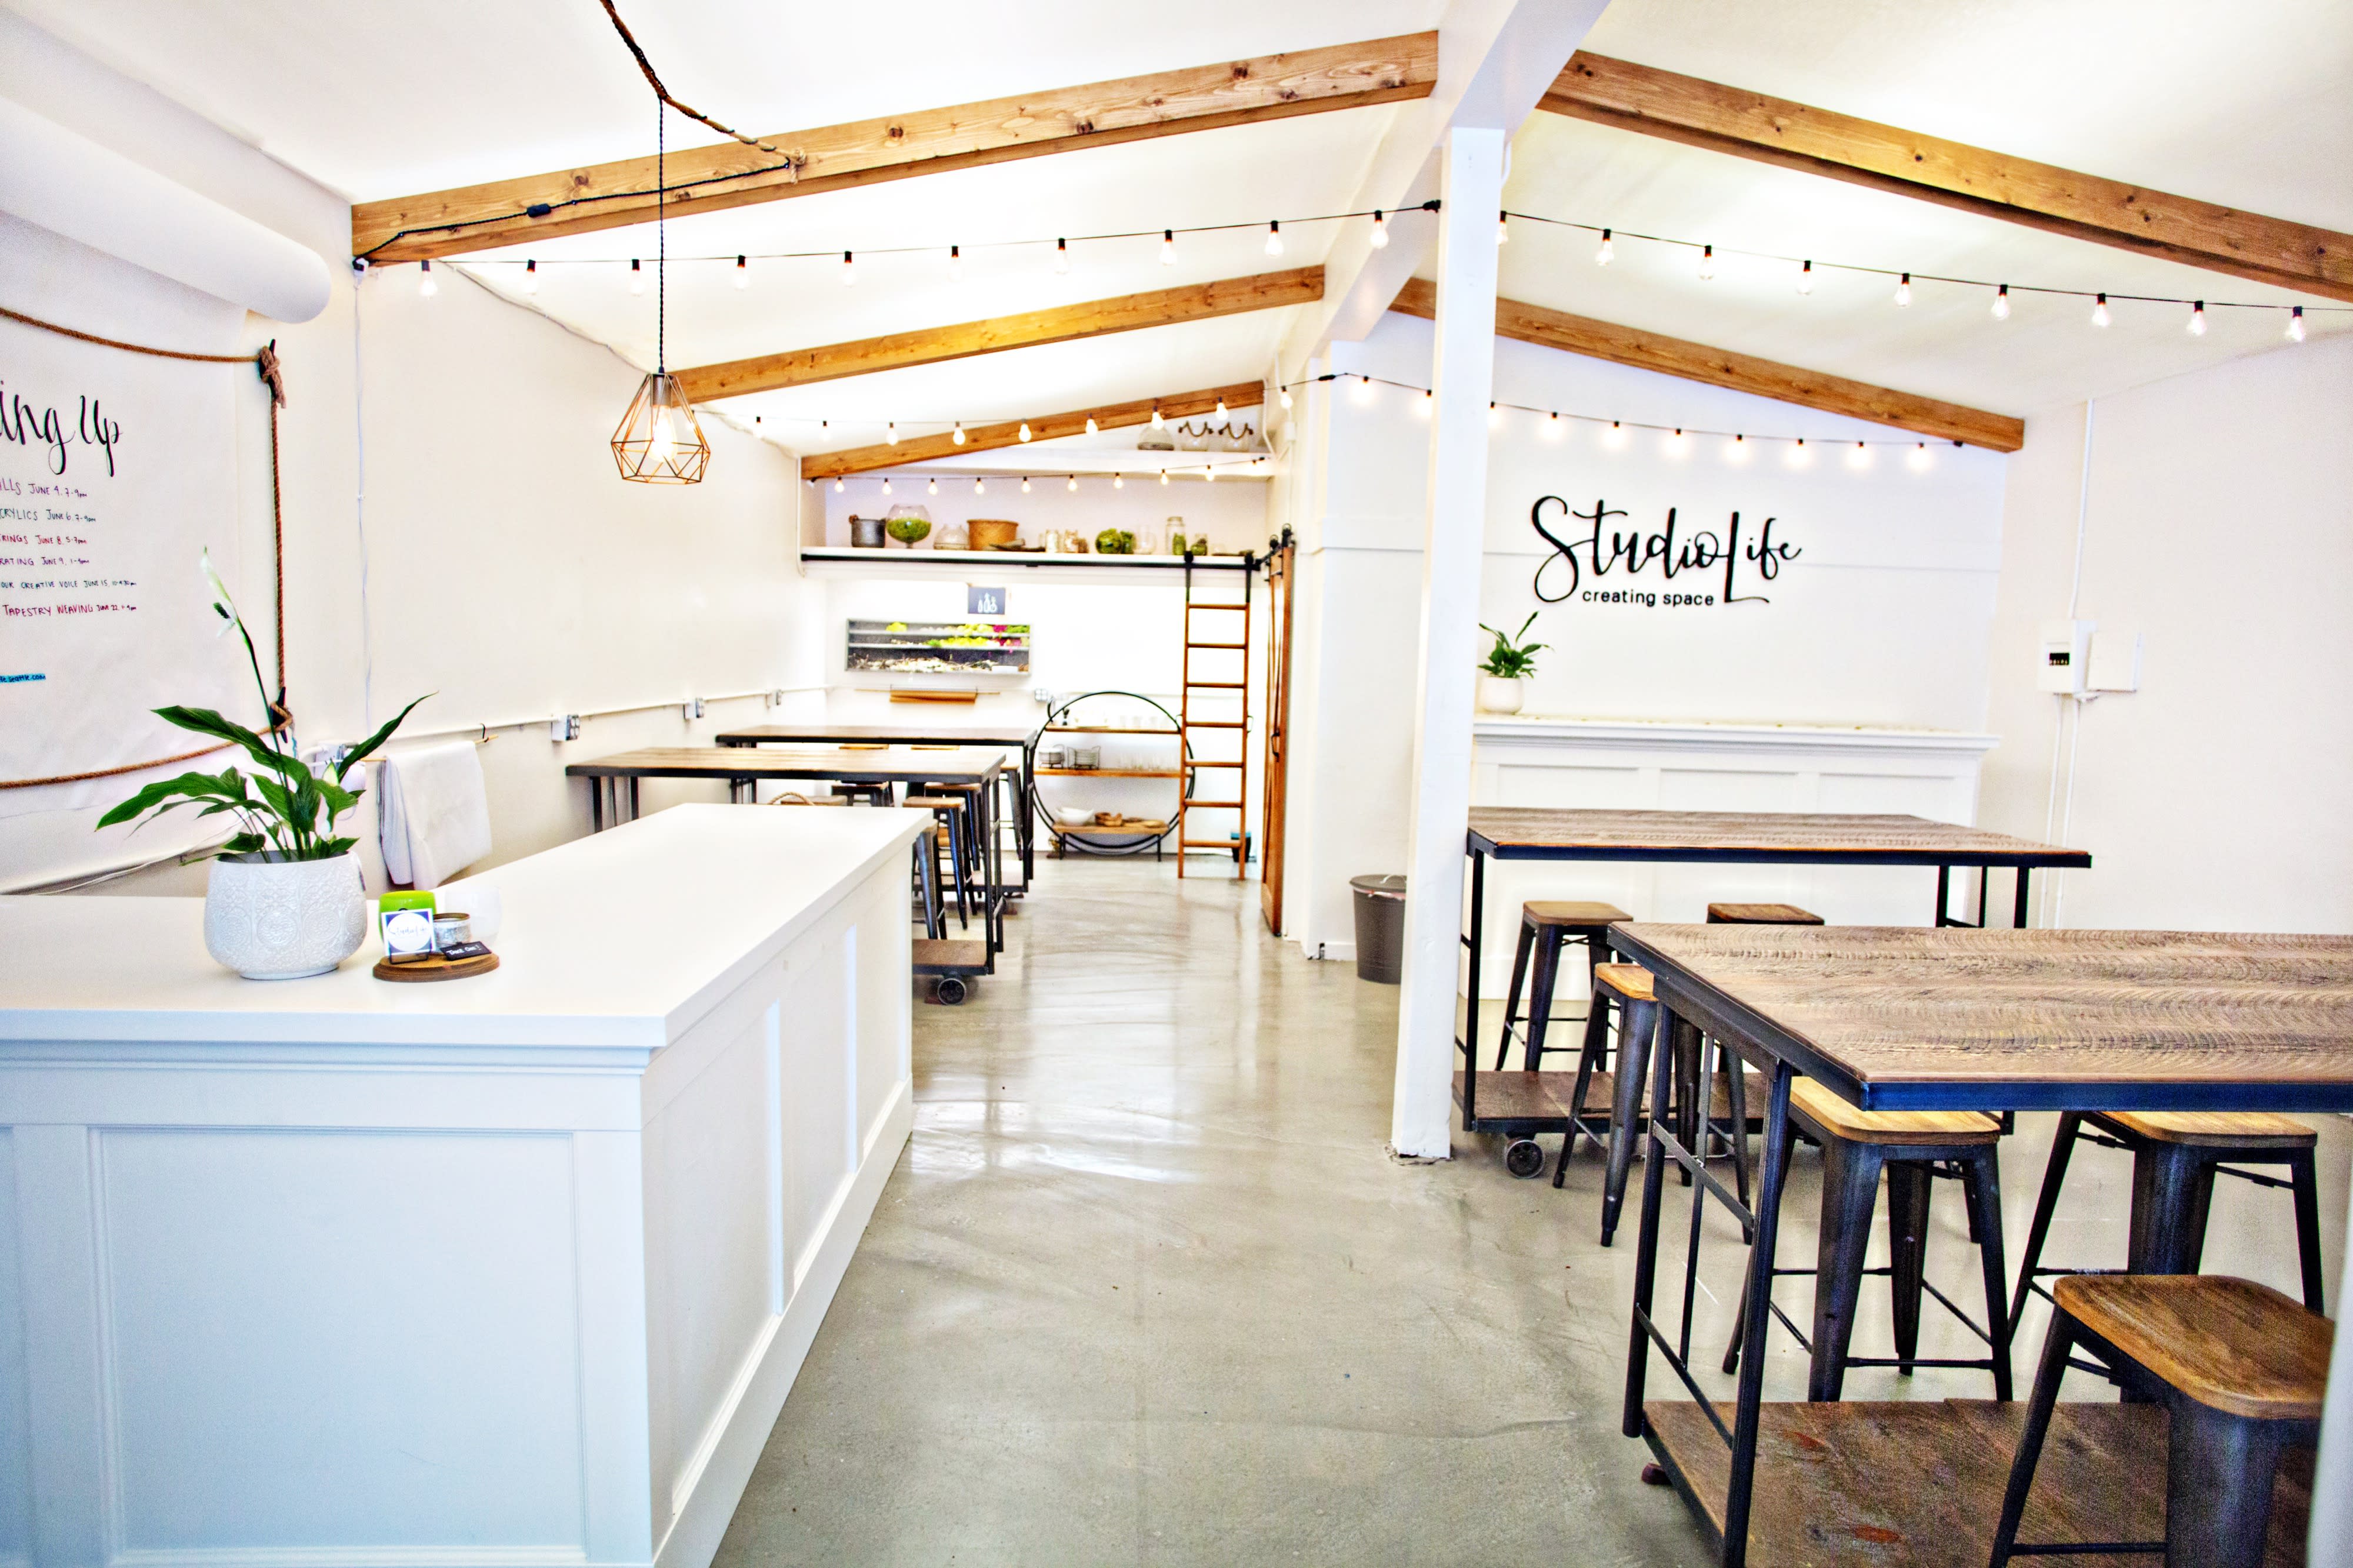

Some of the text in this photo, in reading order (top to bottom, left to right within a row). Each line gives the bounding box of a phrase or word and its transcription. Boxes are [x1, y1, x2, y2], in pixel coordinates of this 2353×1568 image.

[0, 379, 124, 478] ing Up
[0, 478, 21, 496] LLS
[28, 483, 50, 495] JUNE
[0, 508, 38, 521] CRYLICS
[46, 509, 64, 521] JUNE
[0, 534, 29, 545] RINGS
[35, 535, 54, 545] JUNE
[41, 556, 57, 565] JUNE
[1582, 589, 1715, 607] creating space
[2, 604, 52, 616] TAPESTRY
[56, 604, 94, 614] WEAVING
